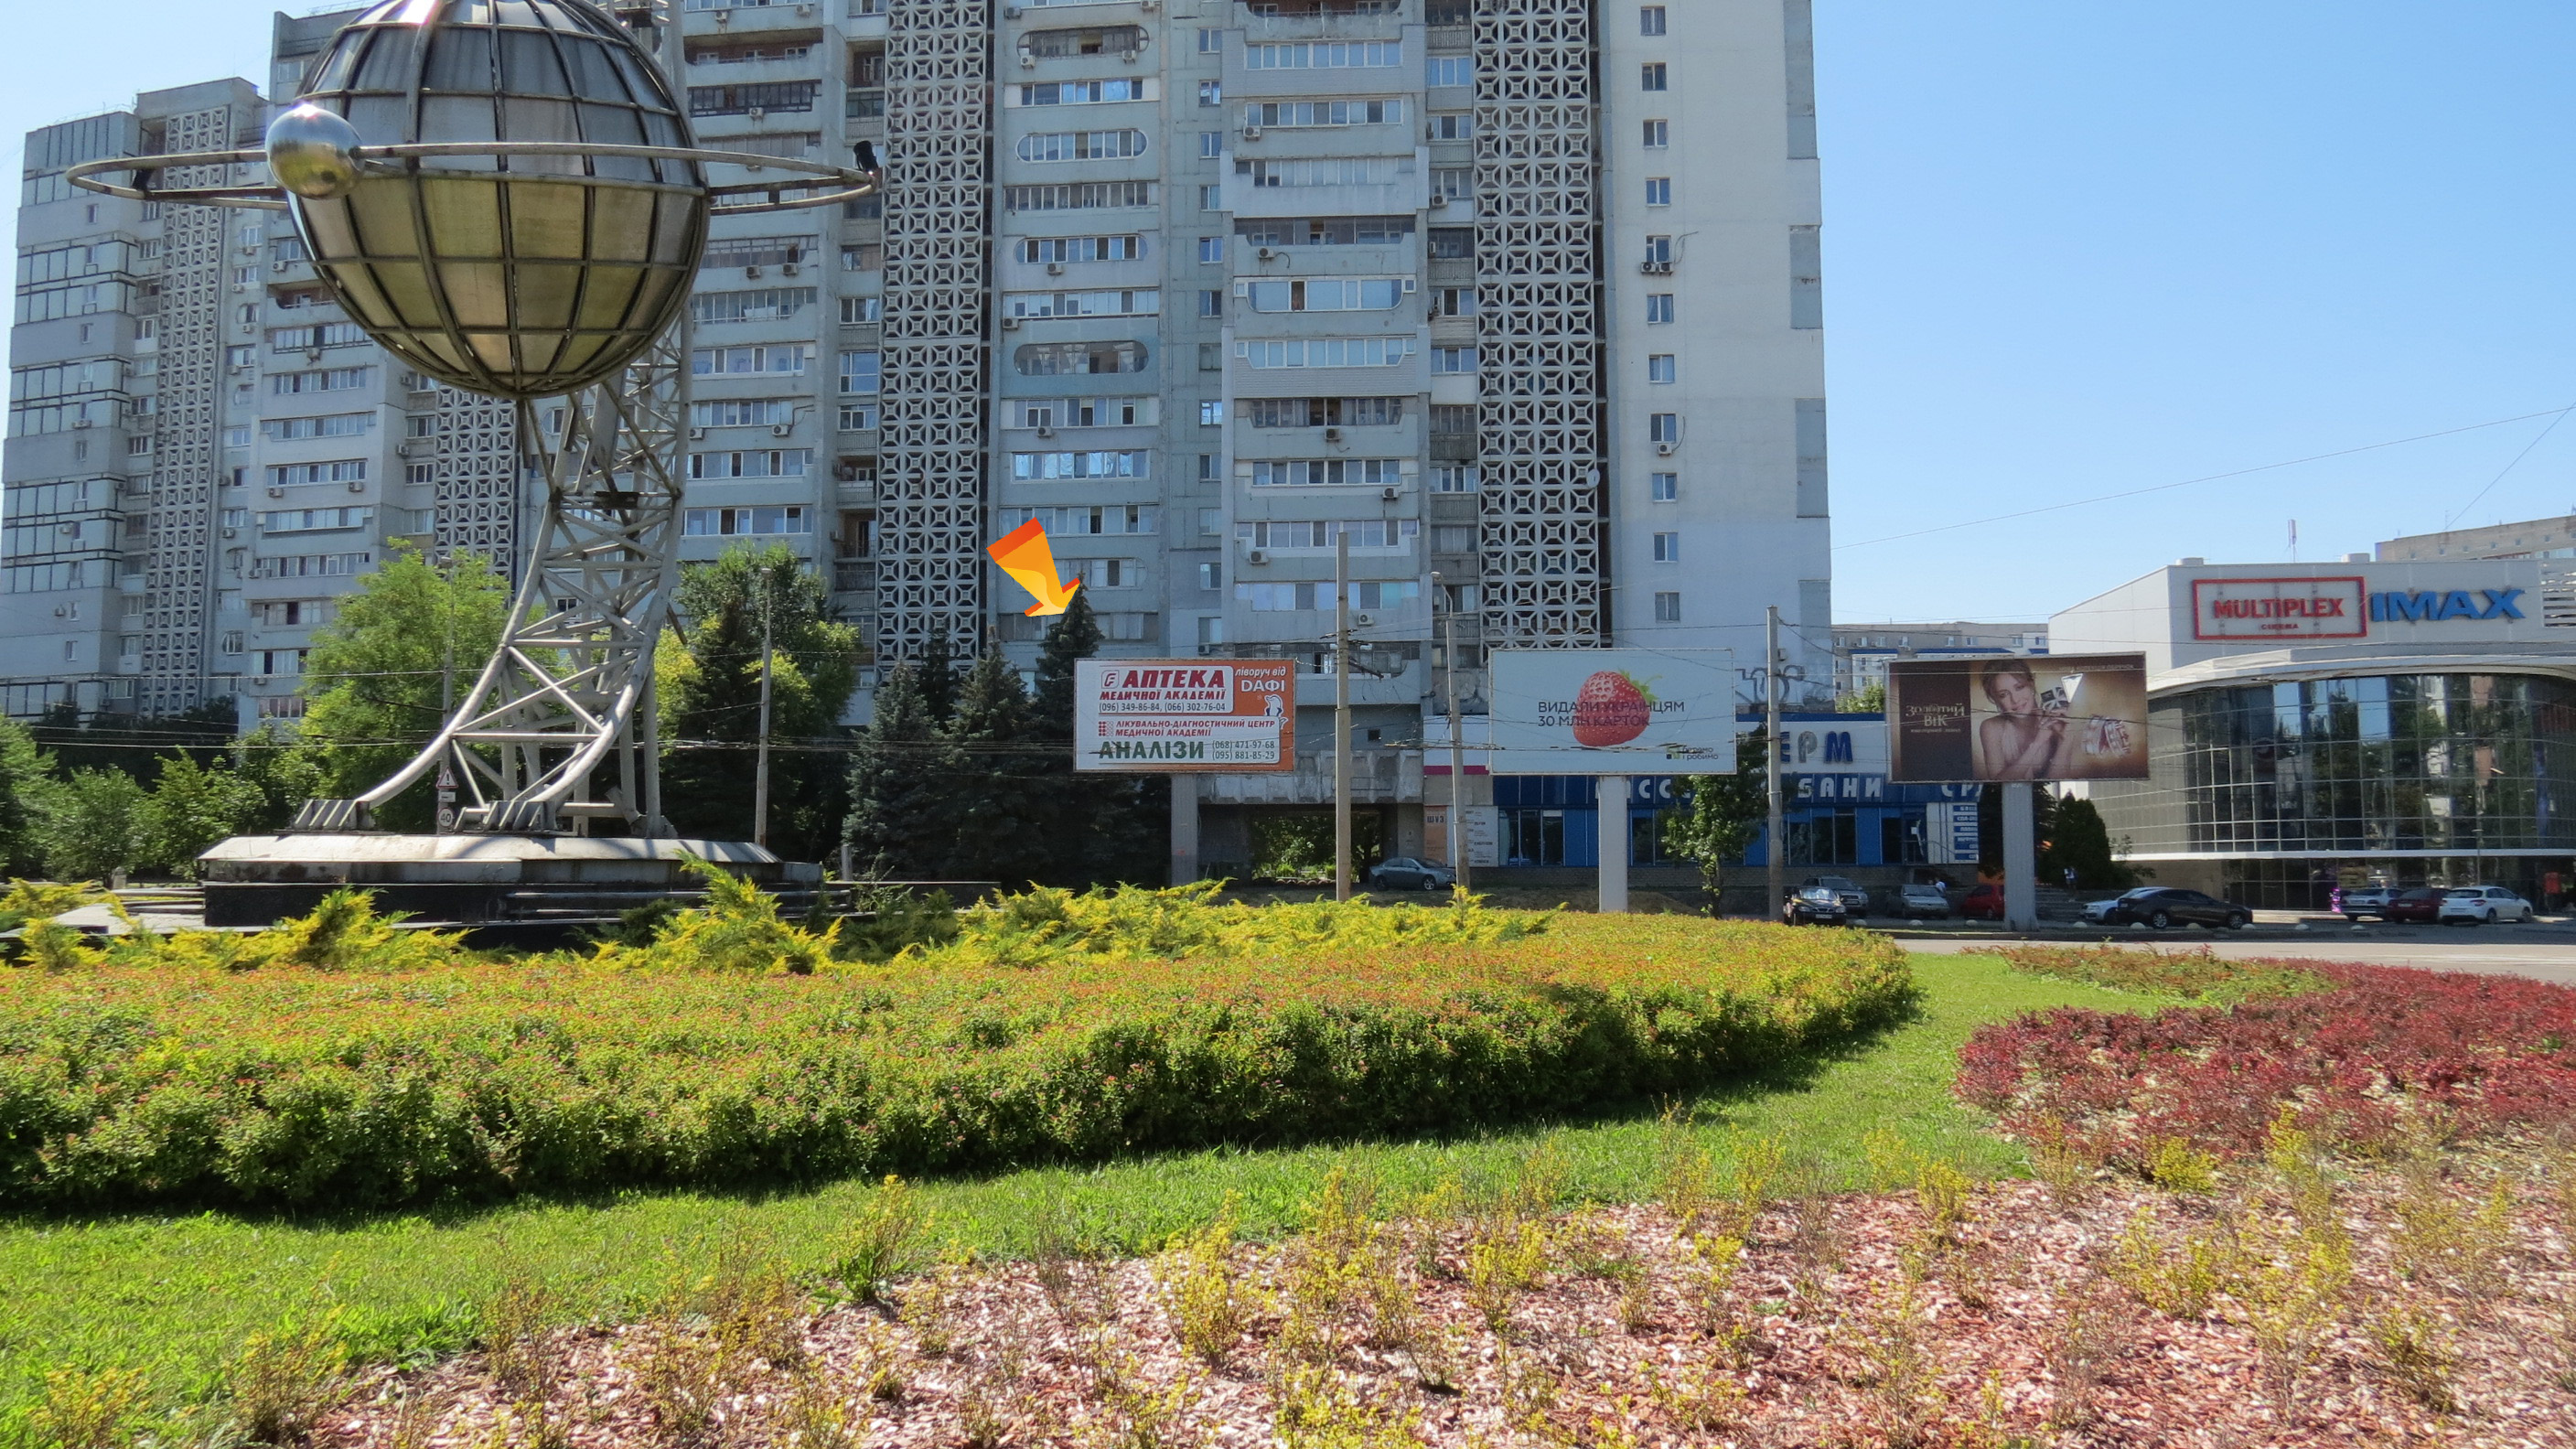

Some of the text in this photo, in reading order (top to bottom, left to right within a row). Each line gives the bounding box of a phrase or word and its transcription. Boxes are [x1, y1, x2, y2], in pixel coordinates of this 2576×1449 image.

[2214, 589, 2526, 622] MULTIPLEX IMAX
[1235, 666, 1286, 679] ліворуч від
[1122, 670, 1225, 688] АПТЕКА
[1100, 689, 1226, 701] МЕДИЧНОЇ АКАДЕМІЇ
[1099, 703, 1226, 713] (096) 349-86-84, (066) 302-76-04
[1538, 700, 1684, 714] ВИДАЛИ УКРАЇНЦЯМ
[1115, 719, 1275, 729] ЛІКУВАЛЬНО-ДІАГНОСТИЧНИЙ ЦЕНТР
[1538, 715, 1650, 726] 30 МЛН КАРТОК
[1115, 728, 1211, 737] МЕДИЧНОЇ АКАДЕМІЇ
[1099, 741, 1204, 759] АНАЛІЗИ
[1212, 740, 1275, 749] (068) 471-97-68
[1212, 751, 1275, 760] (095) 881-85-29
[1798, 778, 1882, 799] БАНИ
